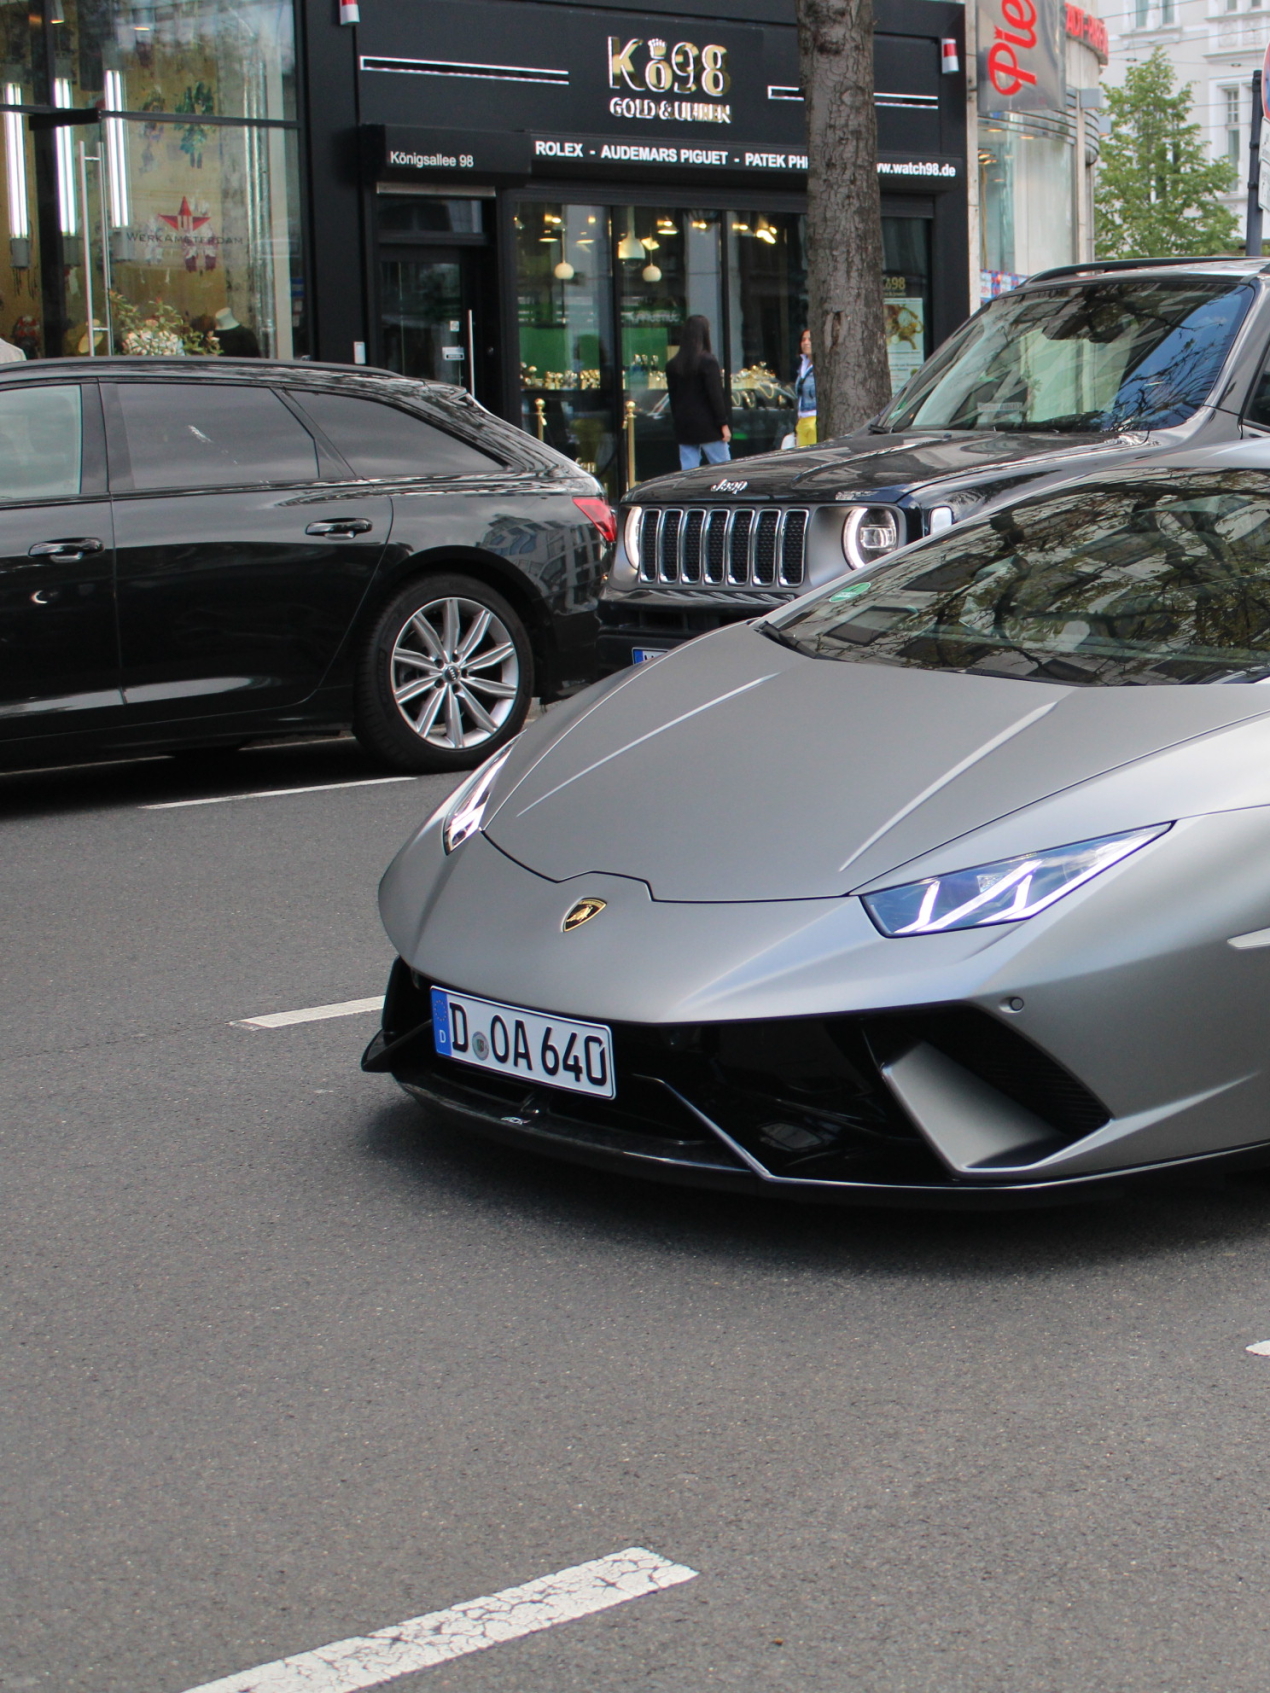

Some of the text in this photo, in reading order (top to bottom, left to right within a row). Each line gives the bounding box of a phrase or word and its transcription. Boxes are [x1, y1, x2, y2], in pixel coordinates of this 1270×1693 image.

[609, 97, 656, 119] GOLD
[390, 151, 474, 168] Königsallee 98
[535, 141, 583, 157] ROLEX
[601, 145, 677, 162] AUDEMARS
[680, 149, 728, 165] PIGUET
[745, 153, 786, 168] PATEK
[788, 155, 808, 169] PHI
[710, 478, 748, 494] Jeep
[449, 1002, 607, 1087] D OA 640
